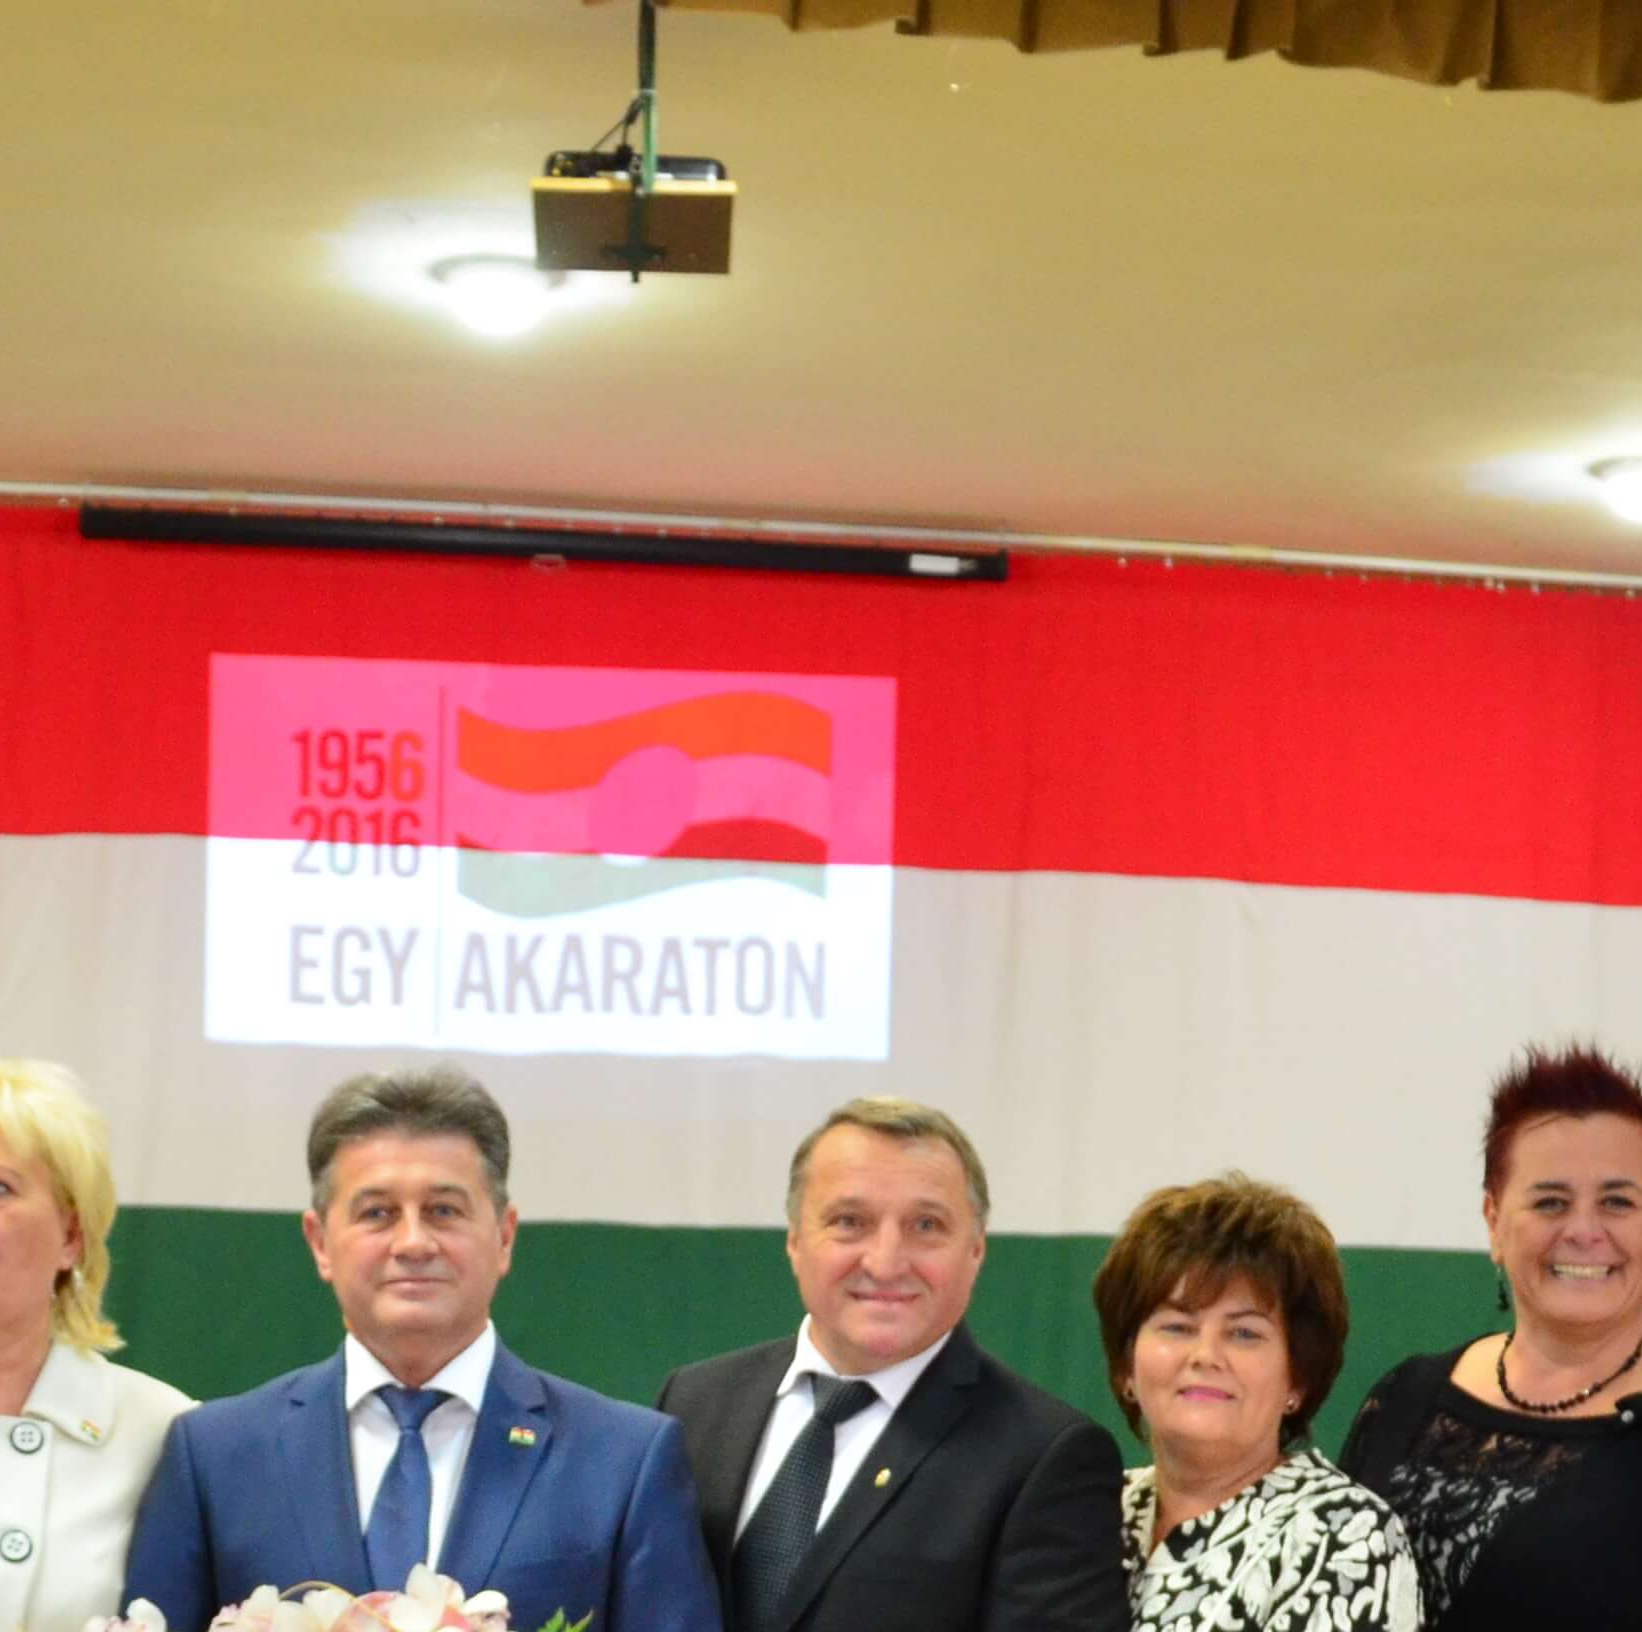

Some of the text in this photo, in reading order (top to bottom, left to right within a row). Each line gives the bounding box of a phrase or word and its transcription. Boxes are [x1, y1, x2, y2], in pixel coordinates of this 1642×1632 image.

[292, 727, 425, 803] 1956
[292, 806, 422, 878] 2016
[288, 924, 826, 1020] EGY AKARATON
